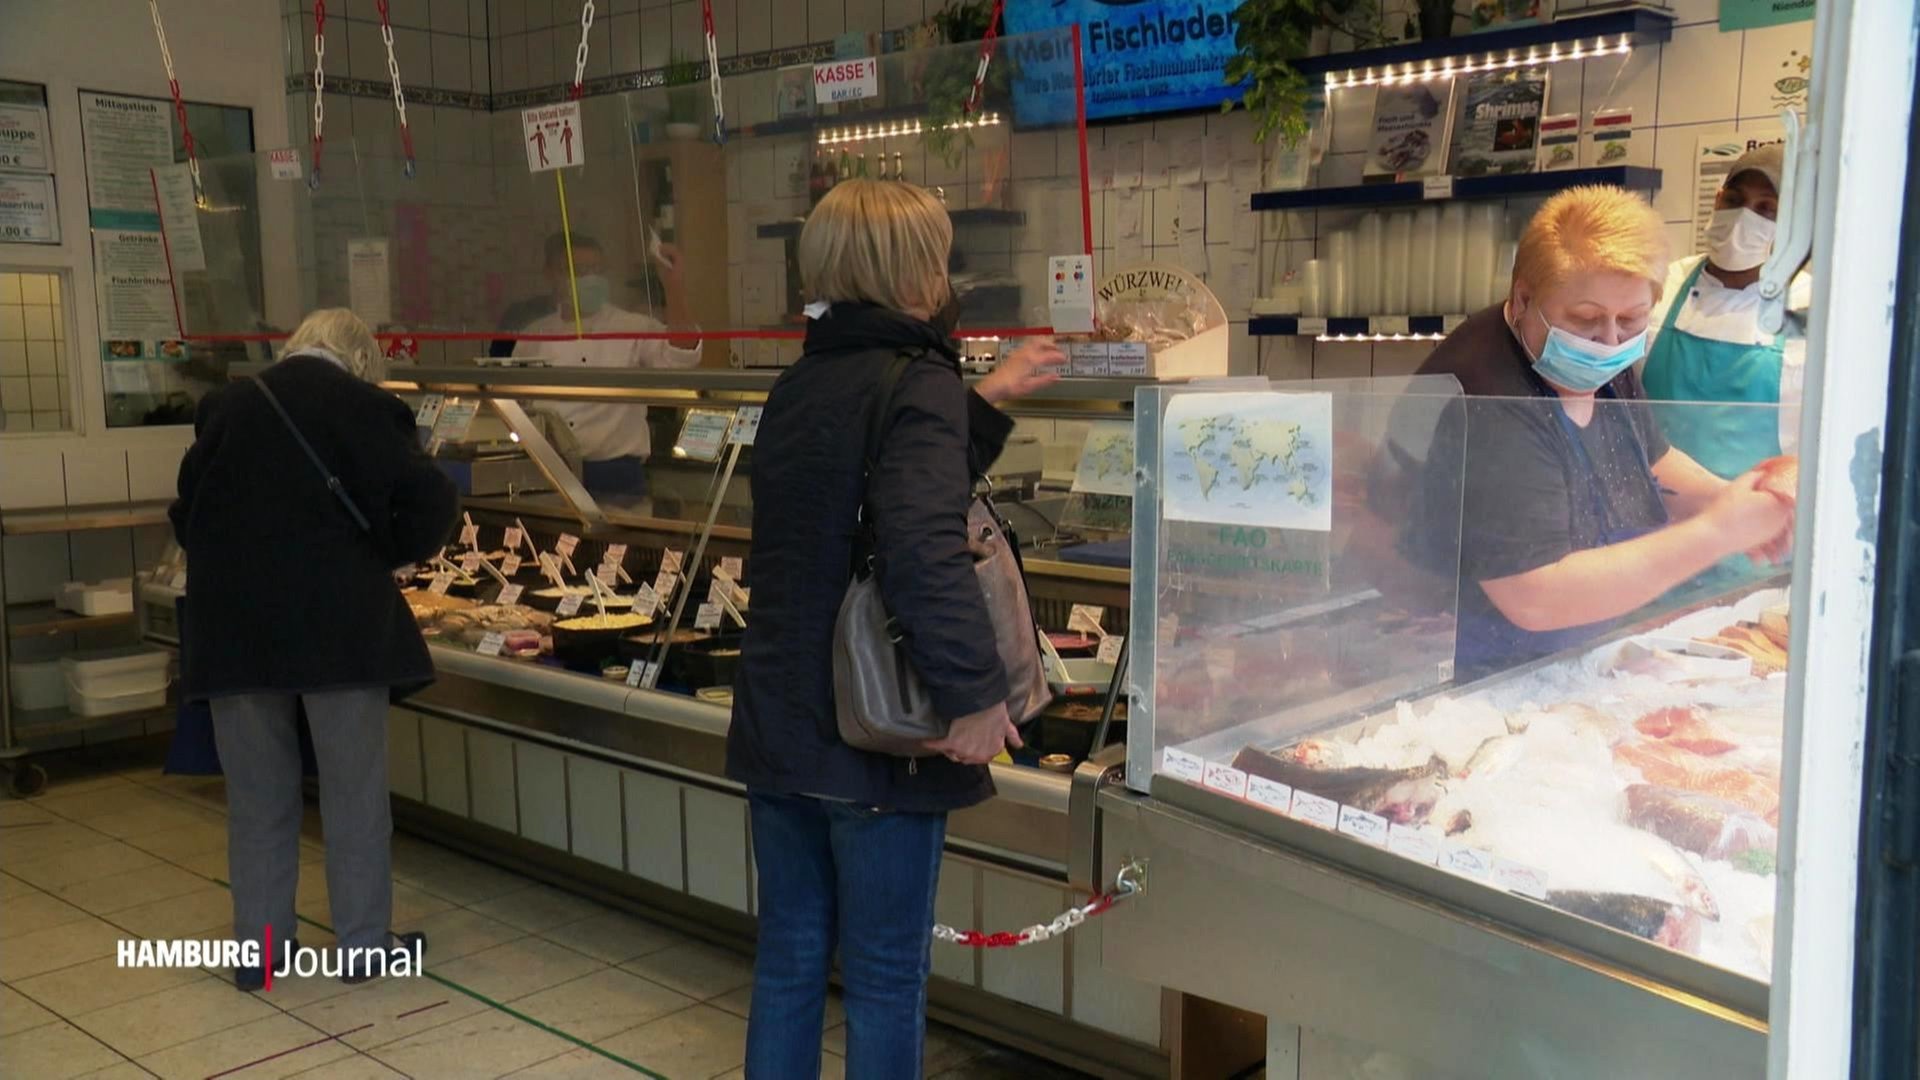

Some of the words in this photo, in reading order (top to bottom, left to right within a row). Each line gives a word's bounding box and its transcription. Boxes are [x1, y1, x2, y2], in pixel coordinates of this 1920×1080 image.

[815, 63, 864, 85] KASSE
[868, 60, 875, 77] 1
[95, 98, 157, 112] Mittagstisch
[1475, 100, 1539, 119] Shrimps
[0, 128, 35, 140] uppe
[1218, 525, 1269, 549] FAO
